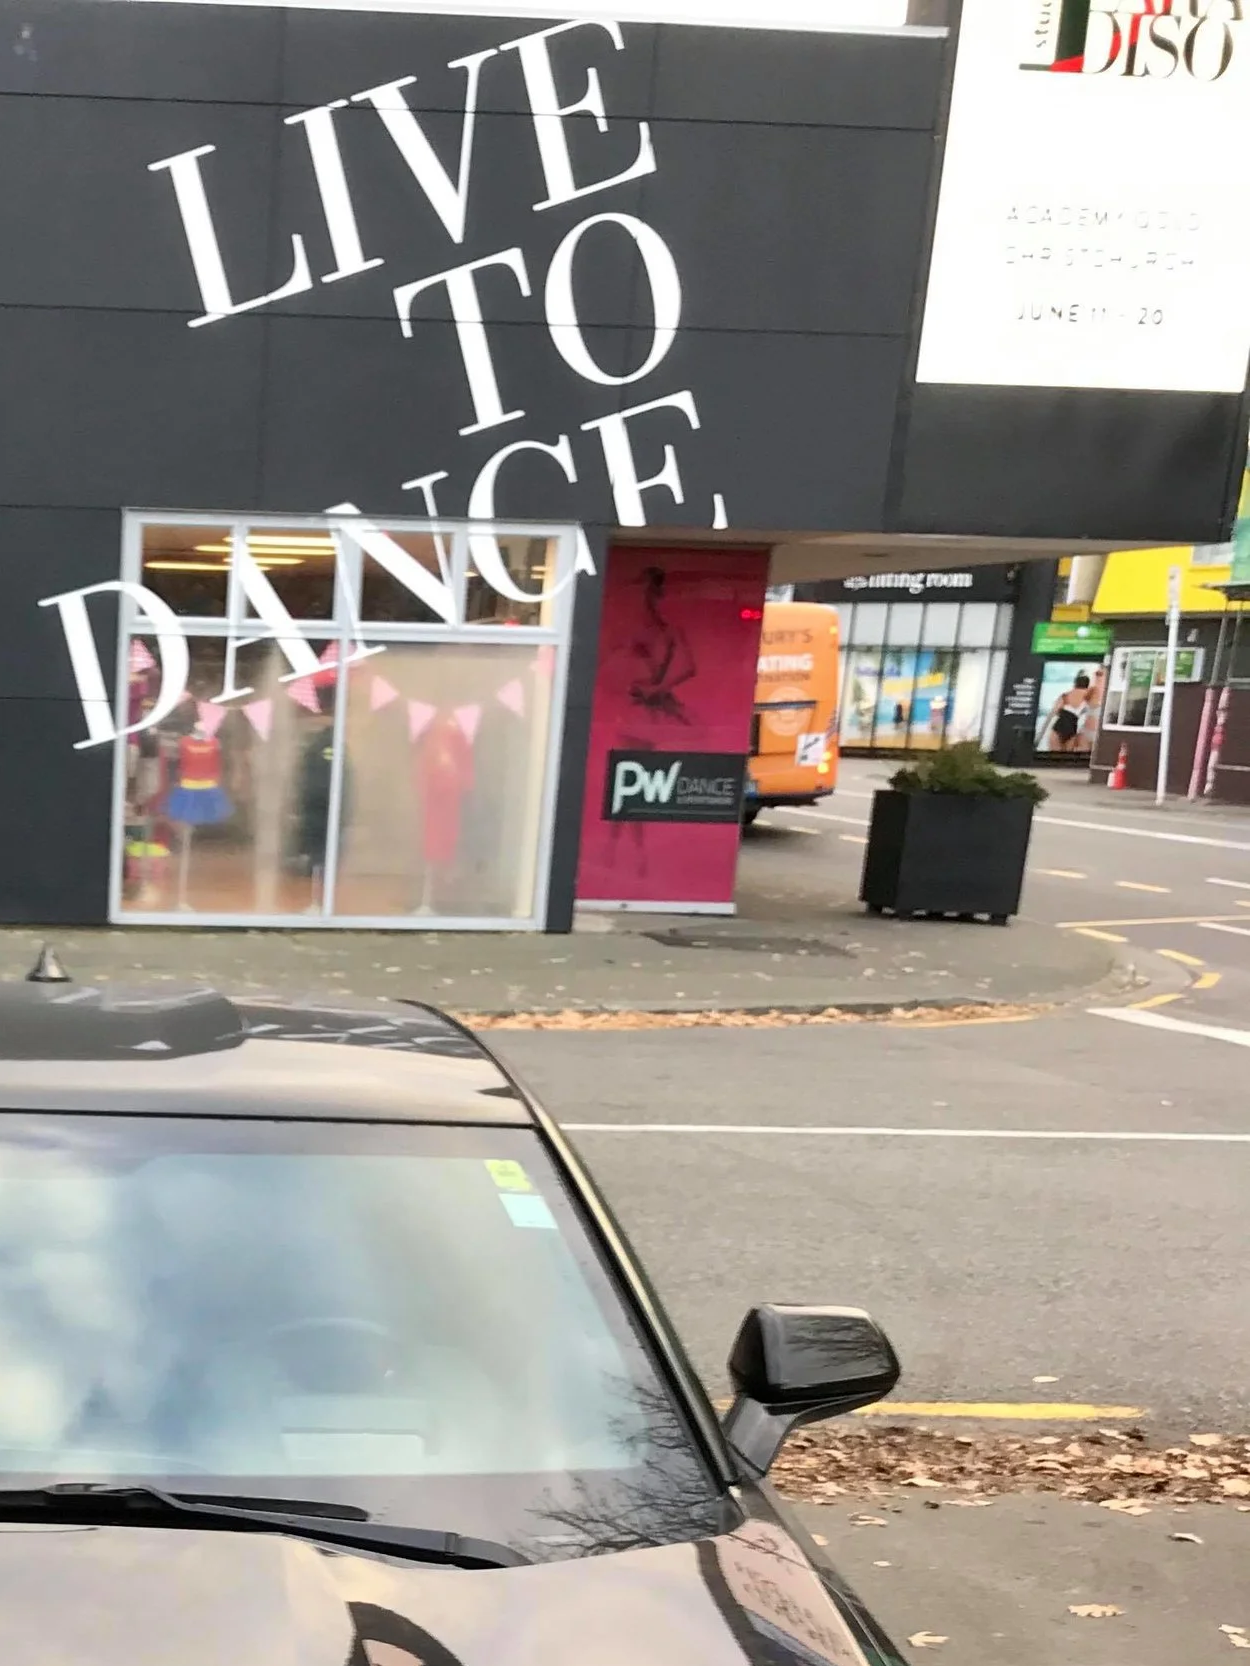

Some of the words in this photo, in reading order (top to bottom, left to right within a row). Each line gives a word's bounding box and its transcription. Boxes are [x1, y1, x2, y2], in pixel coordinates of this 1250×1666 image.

[148, 18, 657, 328] LIVE
[393, 211, 682, 436] TO
[1017, 301, 1082, 323] JUNE
[1136, 305, 1165, 325] 20
[38, 390, 729, 750] DANCE
[676, 776, 735, 797] DANCE
